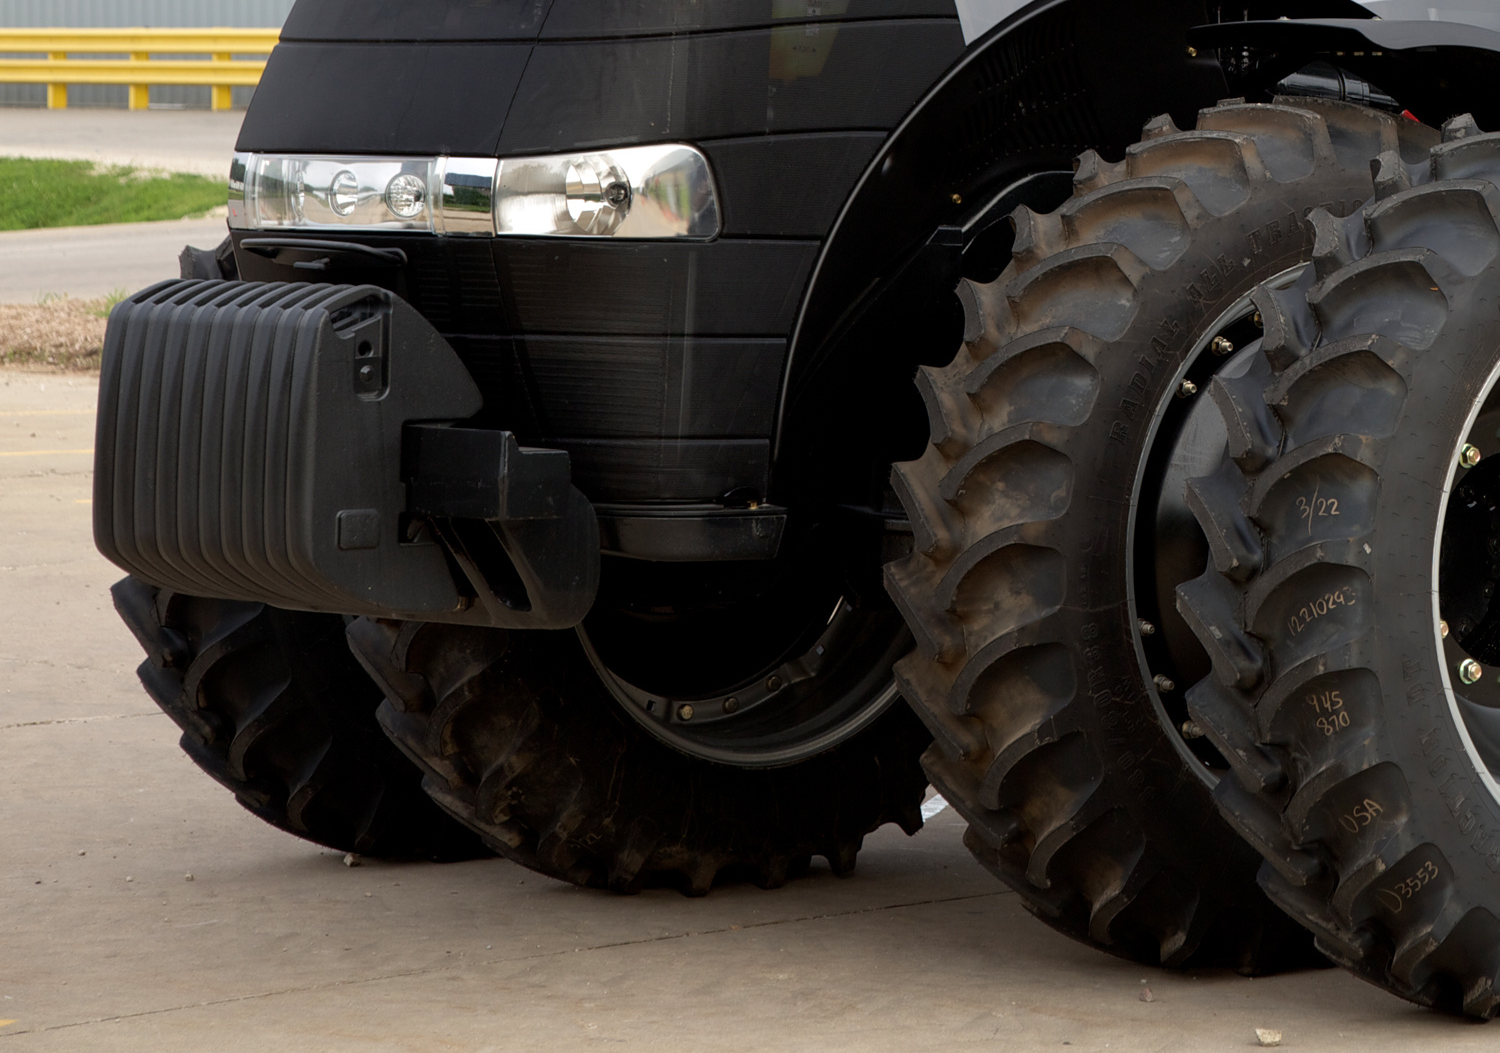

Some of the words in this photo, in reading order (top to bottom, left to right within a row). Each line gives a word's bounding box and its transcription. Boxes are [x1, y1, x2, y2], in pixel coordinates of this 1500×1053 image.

[1109, 318, 1181, 446] RADIAL
[1185, 251, 1237, 308] ALL
[1296, 476, 1340, 537] 3/22
[1316, 711, 1350, 736] 870
[1338, 798, 1384, 833] USA
